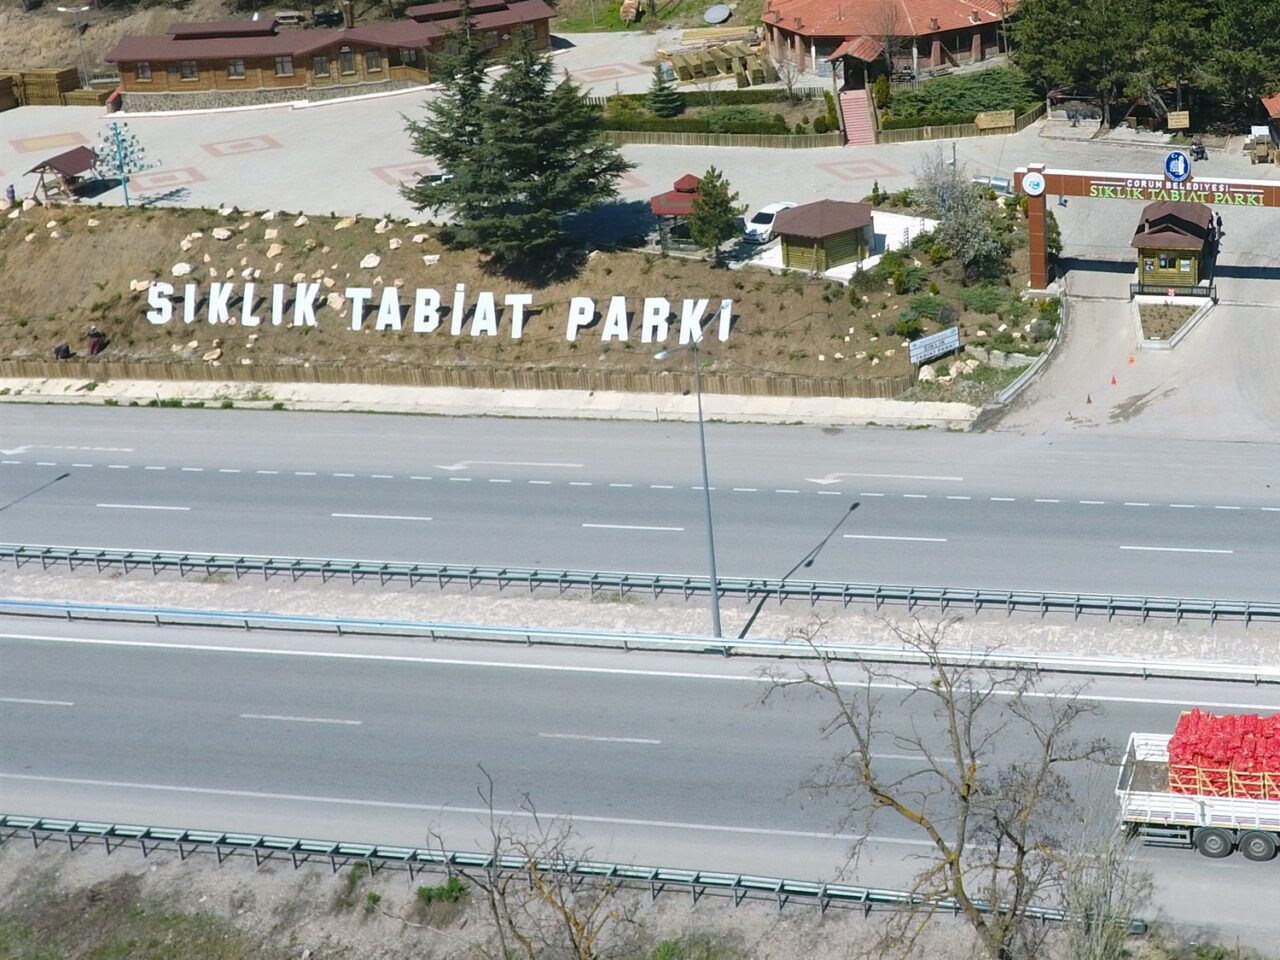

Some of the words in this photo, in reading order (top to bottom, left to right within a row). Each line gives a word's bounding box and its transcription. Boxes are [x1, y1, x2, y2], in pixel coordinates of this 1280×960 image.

[1089, 185, 1144, 199] SIKLIK
[1213, 192, 1265, 206] PARKI
[146, 282, 321, 327] SIKLIK
[345, 283, 533, 339] TABİAT
[566, 295, 733, 345] PARKI
